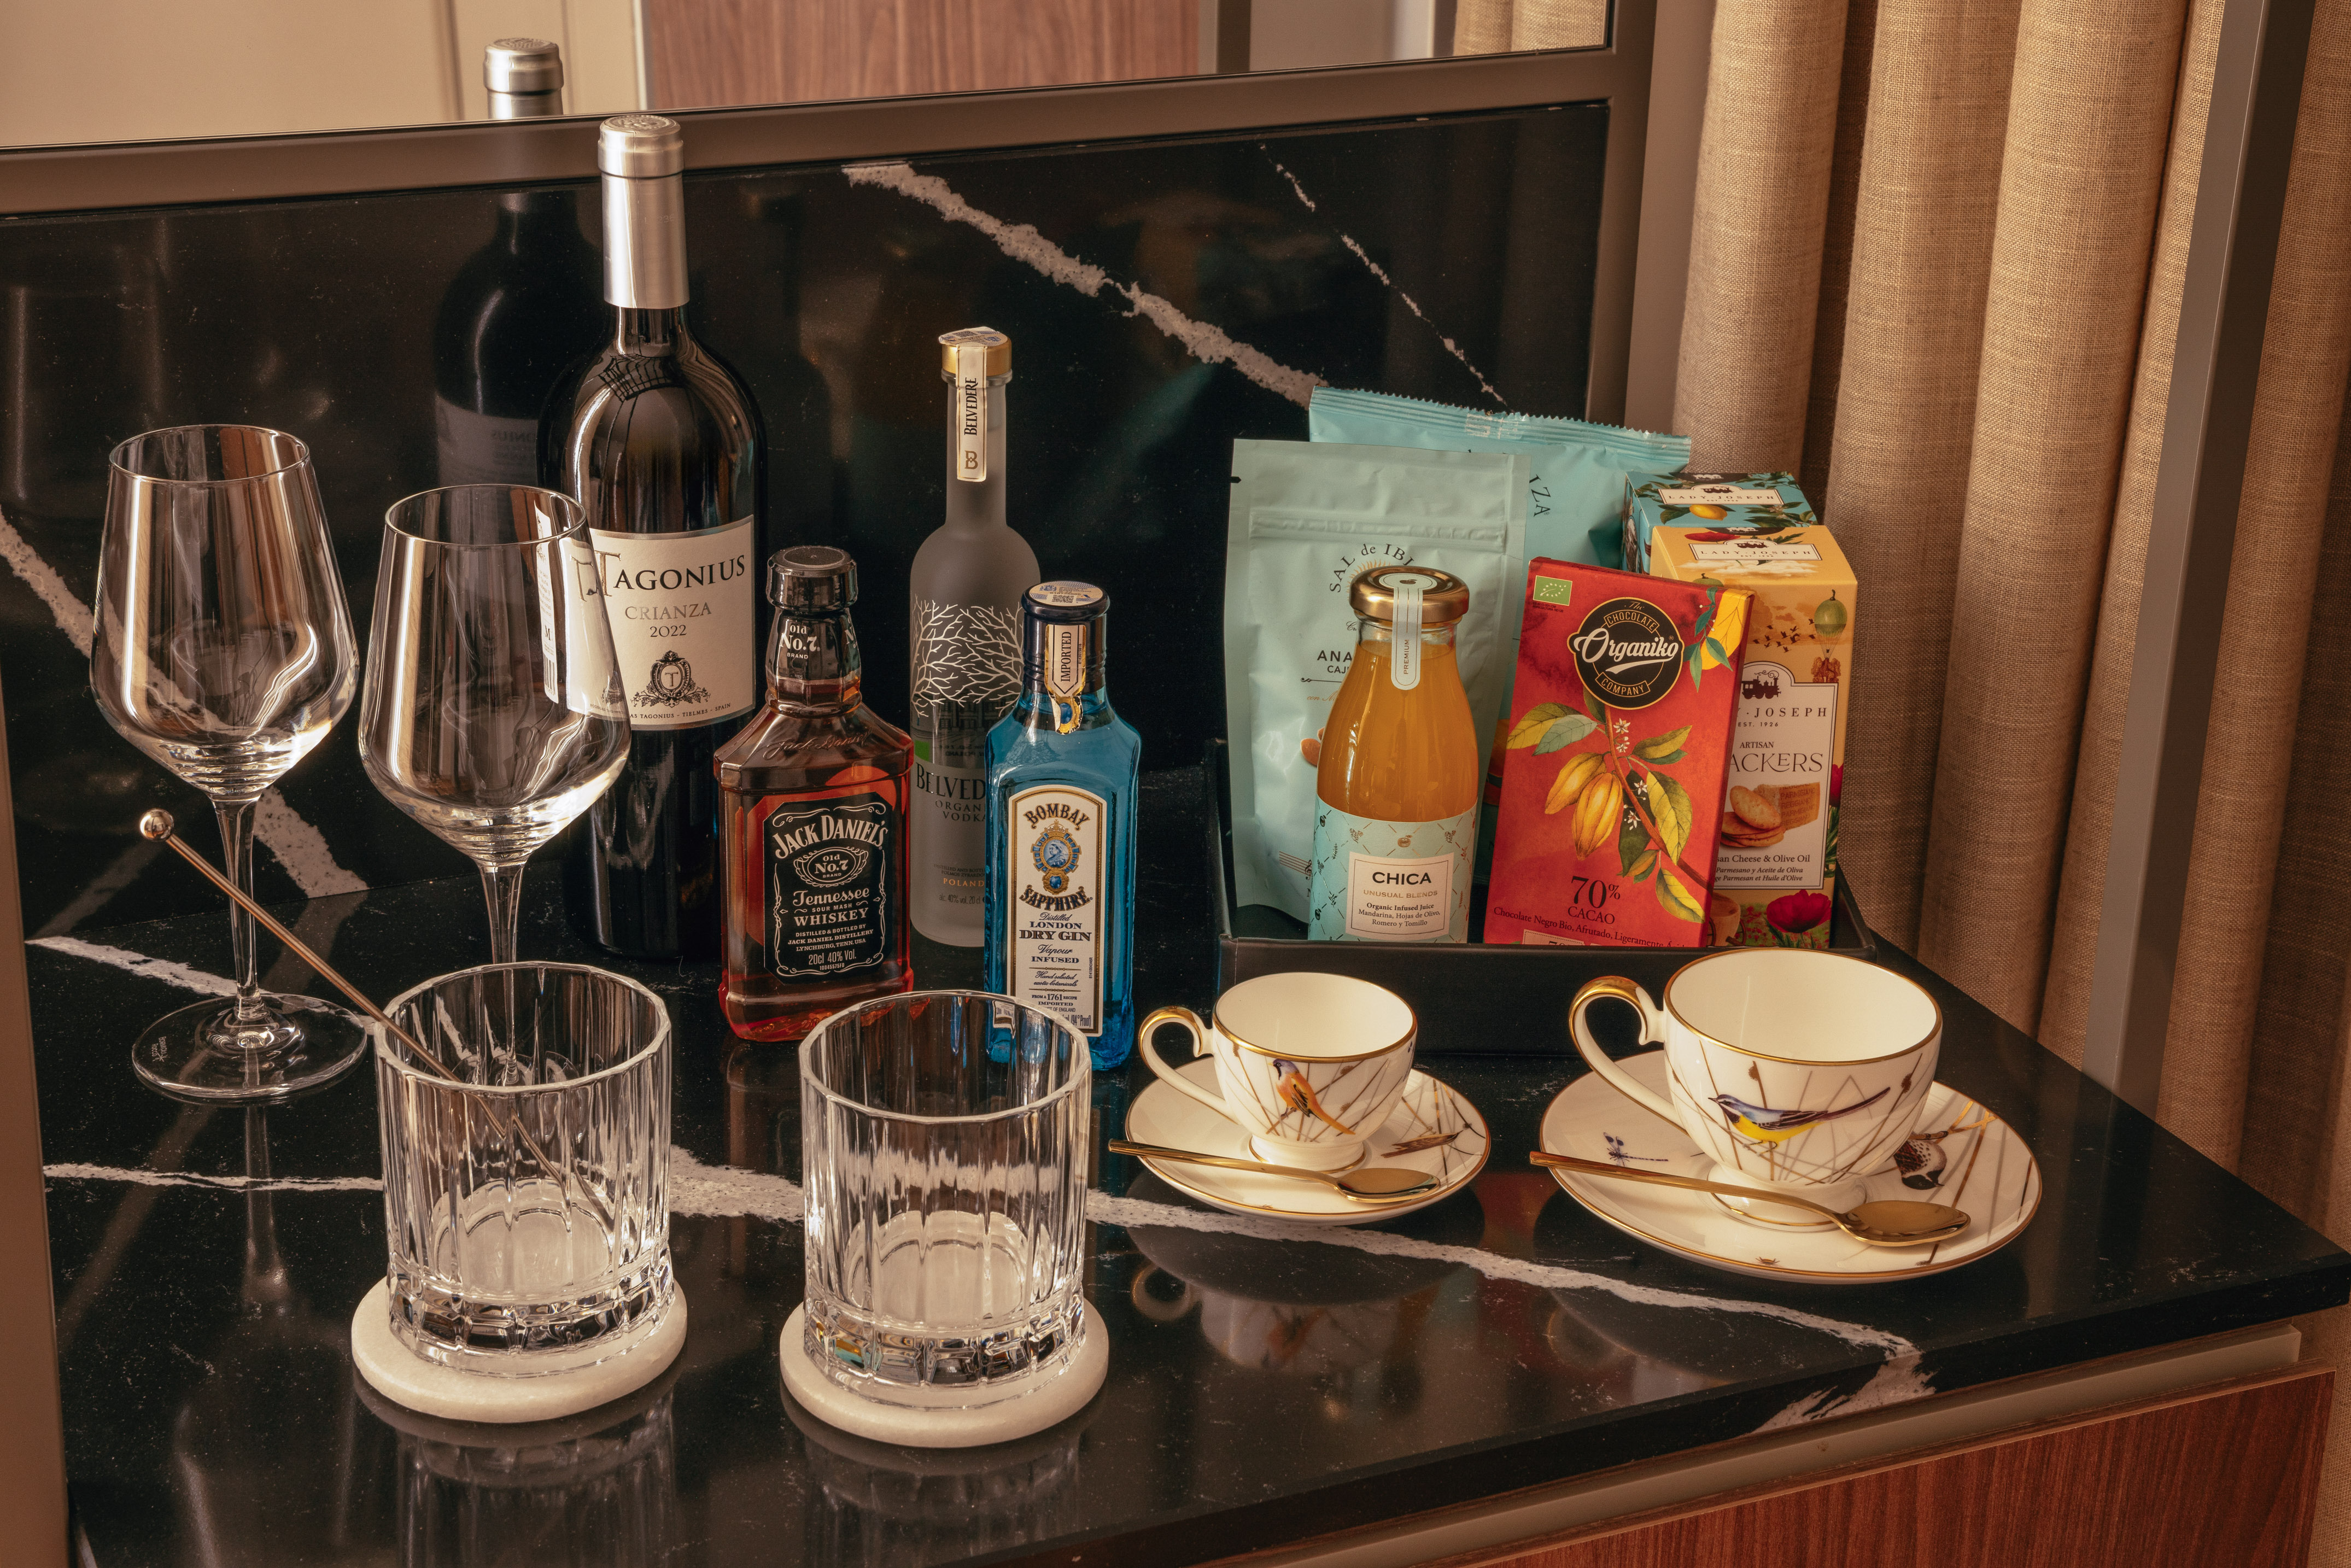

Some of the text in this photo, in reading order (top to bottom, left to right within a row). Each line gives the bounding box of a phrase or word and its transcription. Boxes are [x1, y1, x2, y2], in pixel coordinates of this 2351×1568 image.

[964, 377, 978, 436] BELVEDERE
[595, 550, 745, 597] TAGONIUS
[1330, 555, 1355, 593] SAL
[1361, 543, 1376, 556] de
[625, 602, 712, 621] CRIANZA
[1606, 611, 1657, 631] CHOCOLATE
[650, 624, 687, 638] 2022
[789, 624, 808, 634] Old
[1574, 628, 1679, 663] Organiko
[1061, 631, 1072, 682] IMPORTED
[1327, 665, 1349, 674] CAJ
[665, 671, 679, 687] T
[1601, 678, 1644, 695] COMPANY
[682, 709, 708, 717] TIELMES
[715, 703, 731, 711] SPAIN
[1754, 707, 1827, 718] JOSEPH
[916, 762, 986, 800] BELVED
[1023, 803, 1090, 831] BOMBAY
[773, 815, 888, 859] JACK DANIEL'S
[1732, 854, 1761, 863] Cheese
[1773, 855, 1795, 863] Olive
[1797, 854, 1810, 863] Oil
[943, 877, 985, 887] POLAND
[1372, 871, 1431, 885] CHICA
[793, 888, 869, 906] Tennessee
[948, 894, 959, 904] 40%
[1019, 884, 1091, 911] SAPPHIRE
[1364, 890, 1438, 898] UNUSUAL BLENDS
[1571, 875, 1621, 909] 70%
[1367, 902, 1393, 911] Organic
[794, 908, 869, 927] WHISKEY
[1039, 912, 1073, 922] Distilled
[1359, 909, 1394, 919] Mandarina,
[1568, 906, 1615, 925] CACAO
[832, 925, 858, 934] BOTTLED
[1030, 921, 1083, 929] LONDON
[1494, 906, 1664, 947] Chocolate Negro Bio, Afrutado, Ligeramente
[834, 929, 874, 940] DISTILLERY
[1019, 929, 1092, 942] DRY GIN
[796, 943, 835, 952] LYNCHBURG,
[1038, 944, 1073, 956] Vapour
[809, 949, 857, 966] 20cl 40% Vol.
[1035, 971, 1054, 979] Hand
[1080, 1015, 1091, 1028] Proof)
